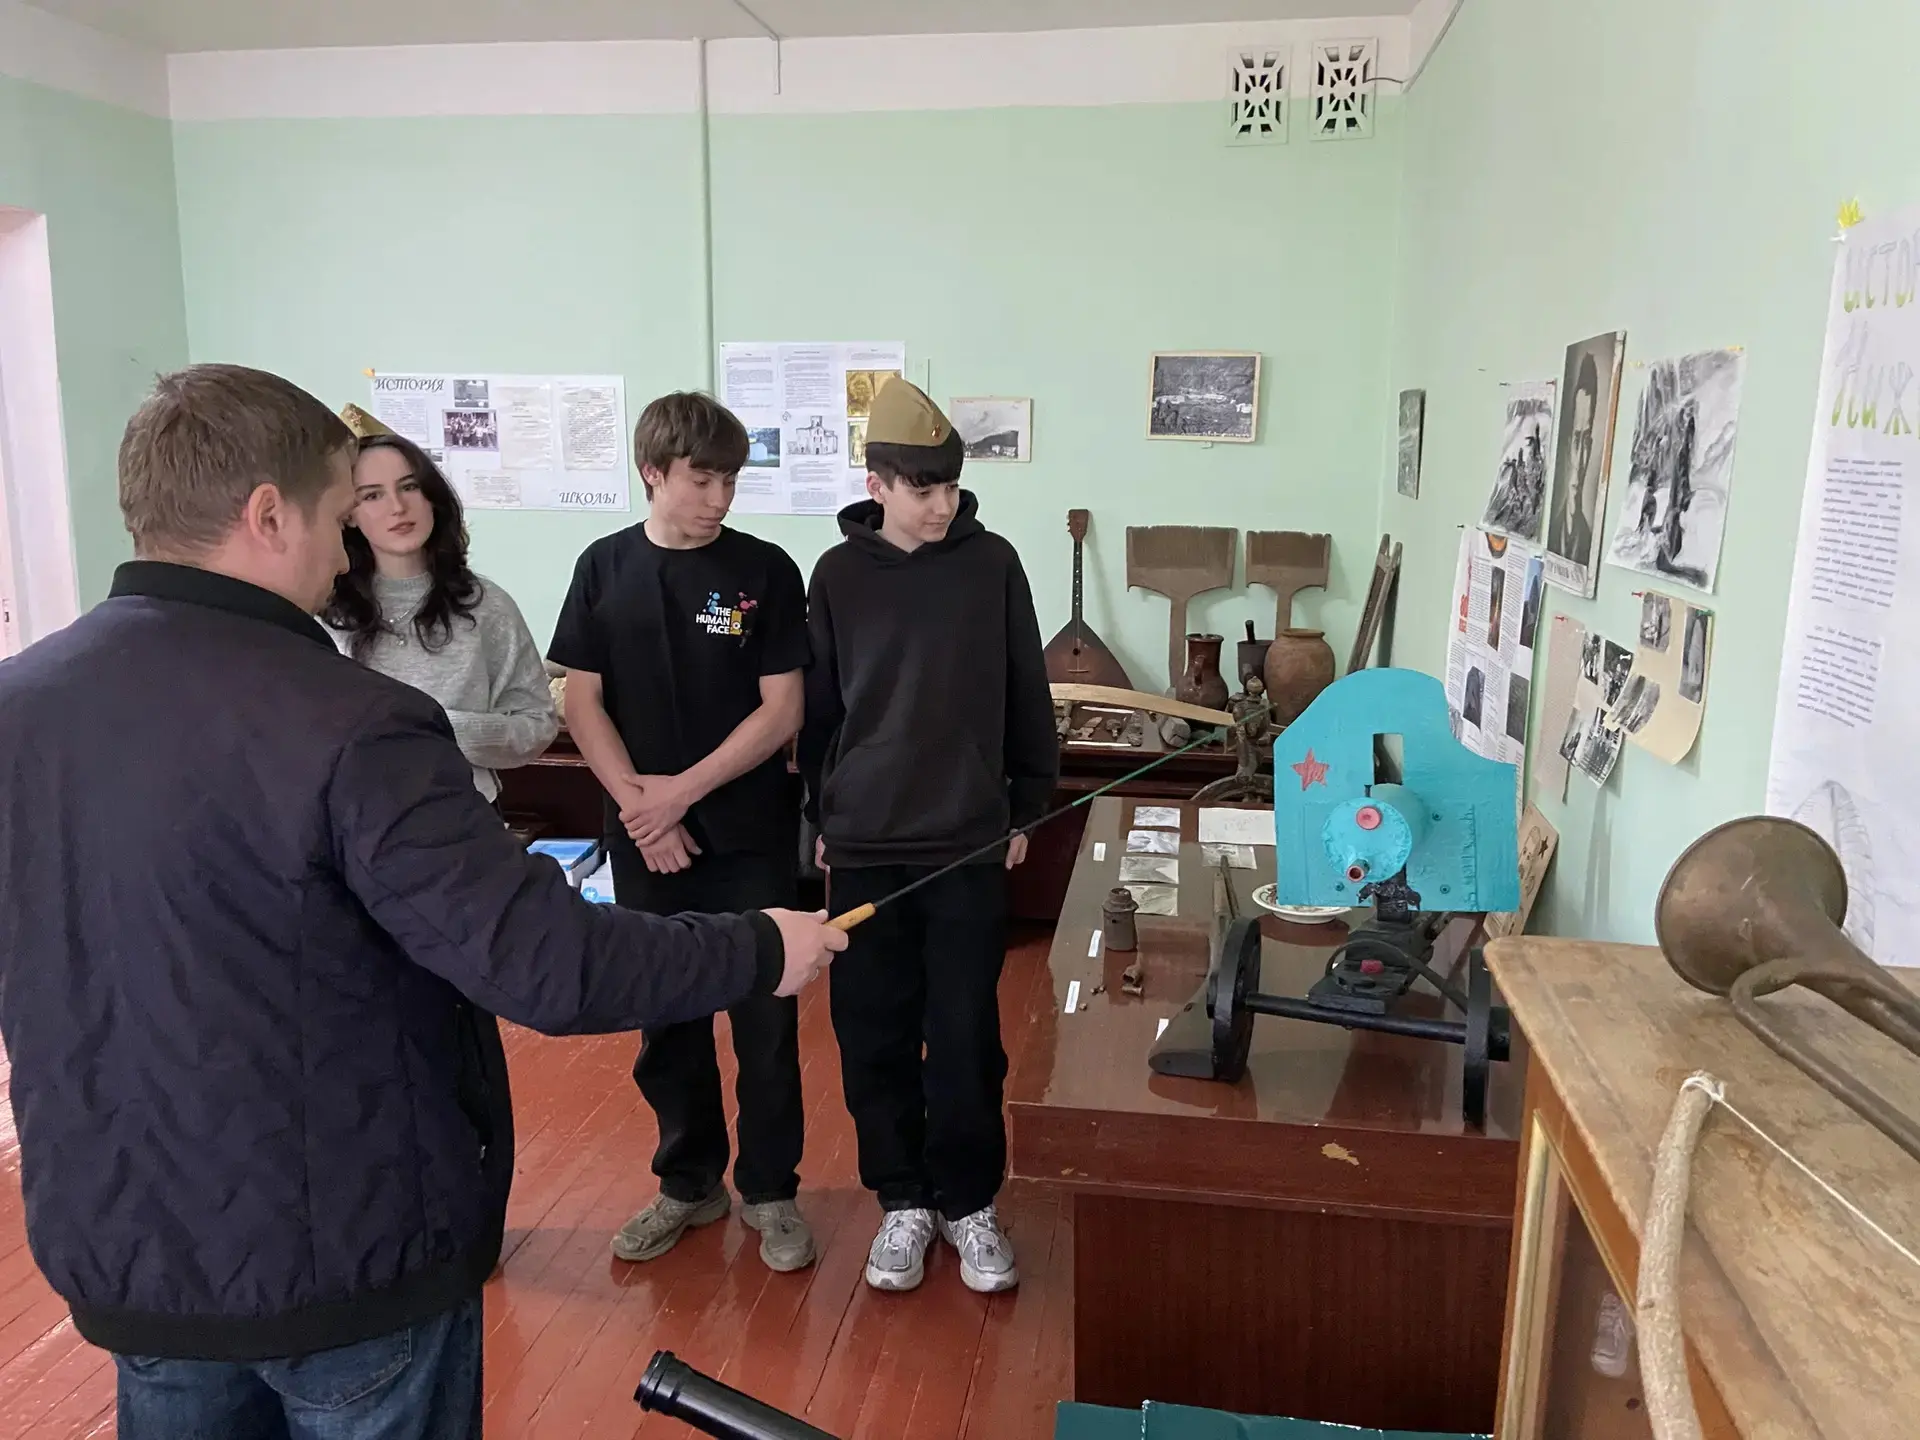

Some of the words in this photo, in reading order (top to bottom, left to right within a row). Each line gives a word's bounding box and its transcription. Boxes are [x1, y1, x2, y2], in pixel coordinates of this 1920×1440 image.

[374, 377, 445, 394] ИСТОРИЯ
[559, 491, 617, 506] ШКОЛЫ
[714, 607, 732, 617] THE
[696, 614, 730, 626] HUMAN
[706, 625, 730, 635] FACE
